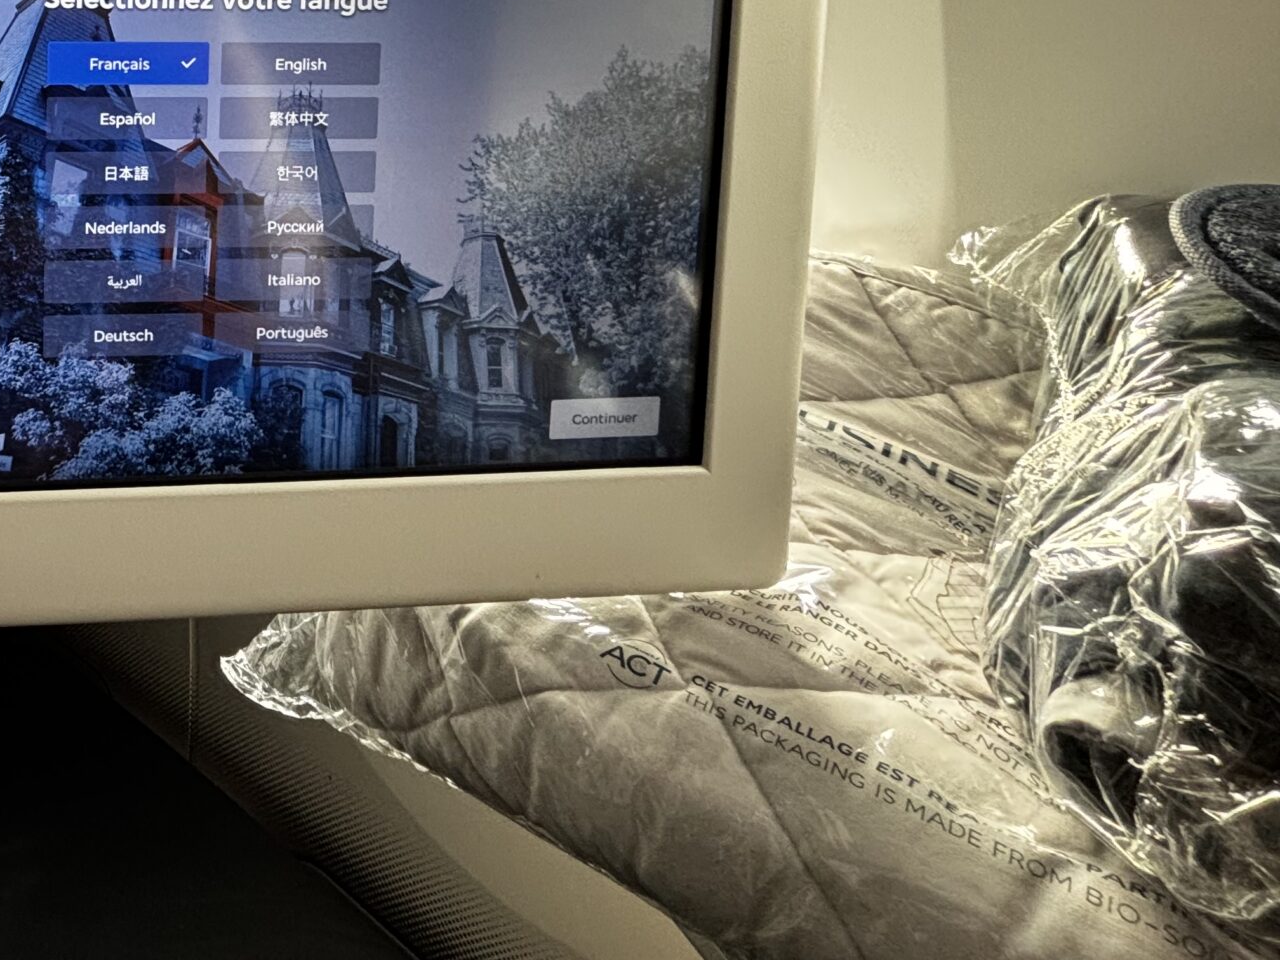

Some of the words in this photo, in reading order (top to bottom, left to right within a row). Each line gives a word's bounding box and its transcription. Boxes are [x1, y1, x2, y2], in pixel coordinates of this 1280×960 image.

[89, 57, 150, 74] Français
[275, 57, 327, 75] English
[99, 111, 156, 129] Español
[104, 165, 149, 182] 日本語
[276, 165, 319, 182] 한국어
[84, 220, 166, 235] Nederlands
[267, 220, 324, 236] Русский
[106, 273, 143, 290] العربية
[267, 273, 321, 287] Italiano
[93, 328, 154, 343] Deutsch
[256, 325, 329, 343] Português
[571, 413, 638, 426] Continuer
[726, 617, 783, 646] STORE
[786, 640, 807, 653] IT
[810, 651, 834, 667] IN
[840, 664, 879, 692] THE
[599, 645, 671, 686] ACT
[691, 674, 729, 698] CET
[734, 695, 868, 765] EMBALLAGE
[875, 761, 920, 788] EST
[685, 691, 726, 721] THIS
[732, 716, 865, 790] PACKAGING
[875, 782, 897, 805] IS
[905, 797, 984, 848] MADE
[991, 843, 1073, 892] FROM
[1085, 885, 1216, 960] BIO-SO
